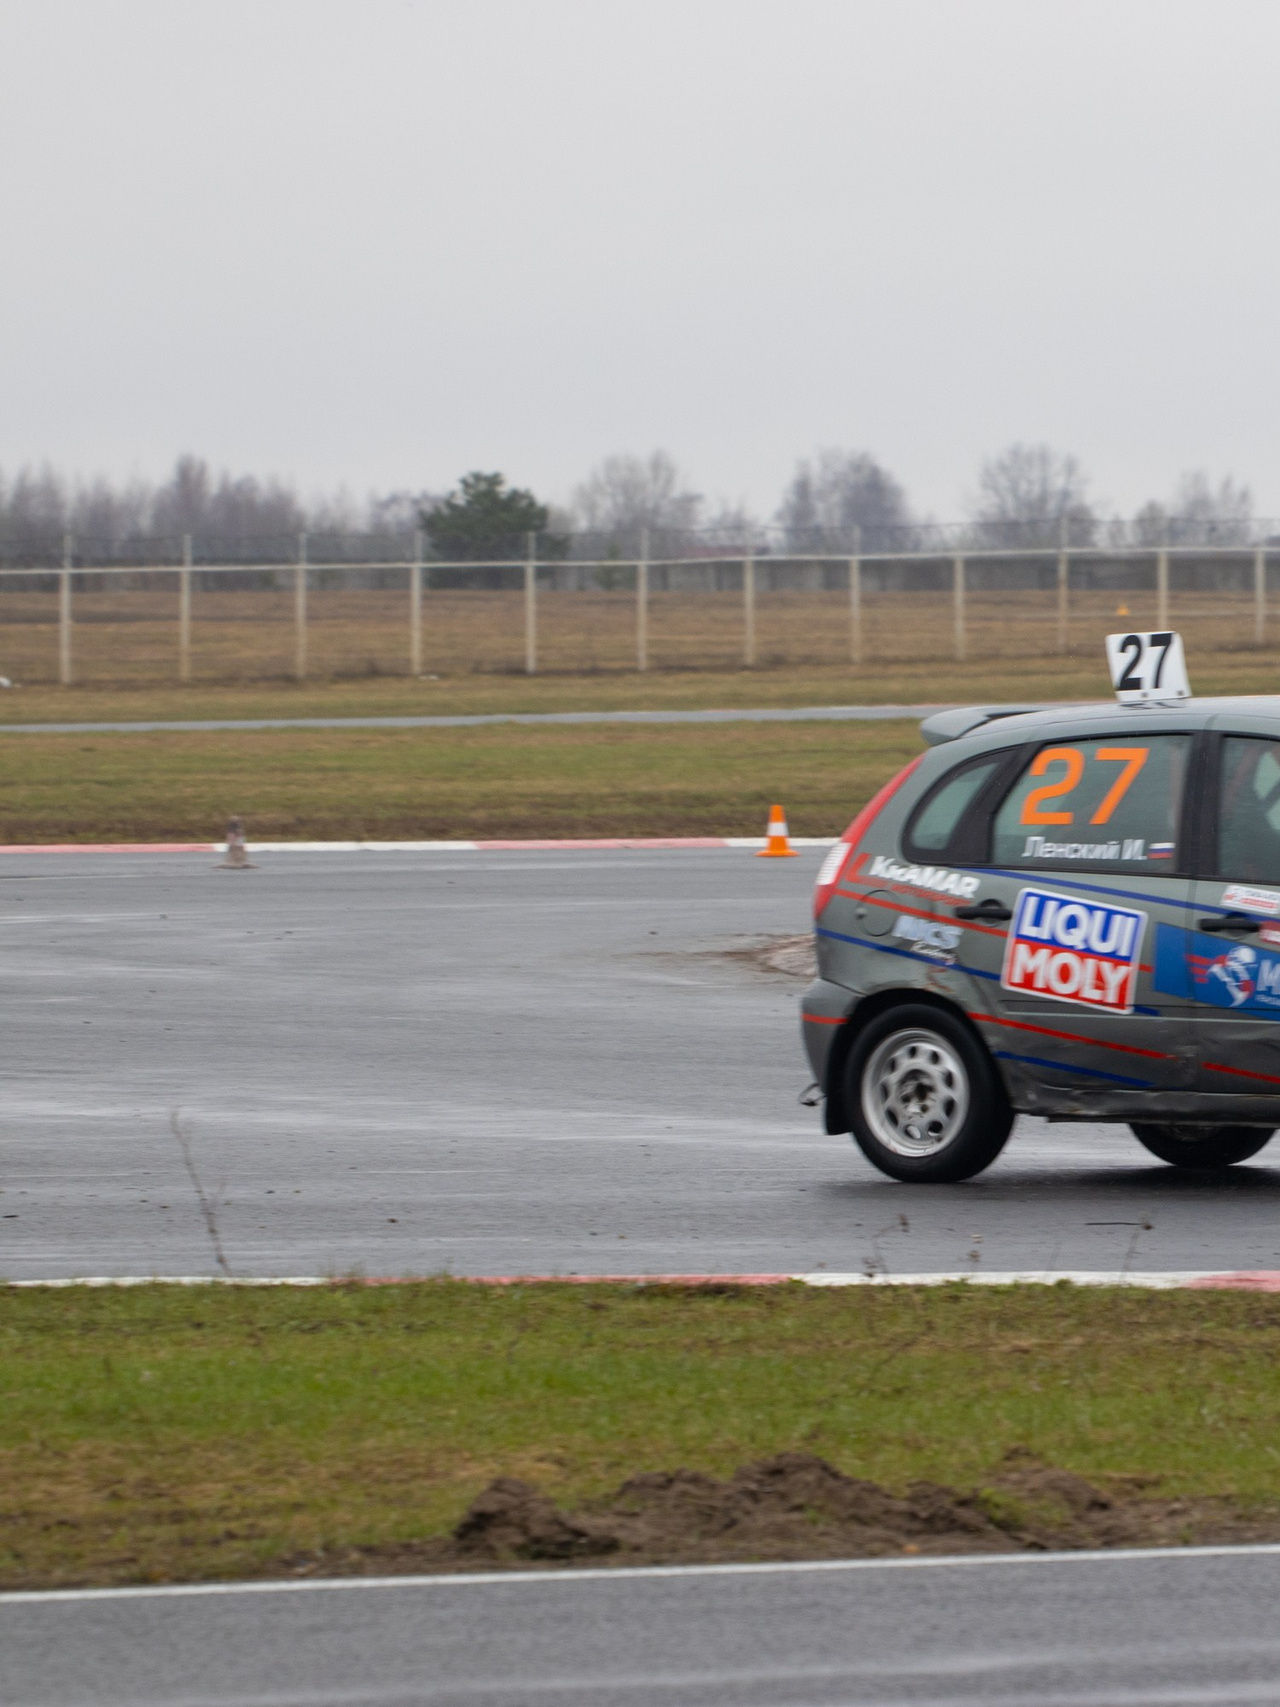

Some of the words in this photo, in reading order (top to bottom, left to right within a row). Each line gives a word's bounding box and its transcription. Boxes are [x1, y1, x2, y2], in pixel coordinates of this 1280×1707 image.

[1117, 632, 1173, 691] 27
[1019, 747, 1150, 825] 27
[1021, 836, 1121, 859] Ленский
[1018, 896, 1139, 957] LIQUI
[1010, 944, 1134, 1003] MOLY
